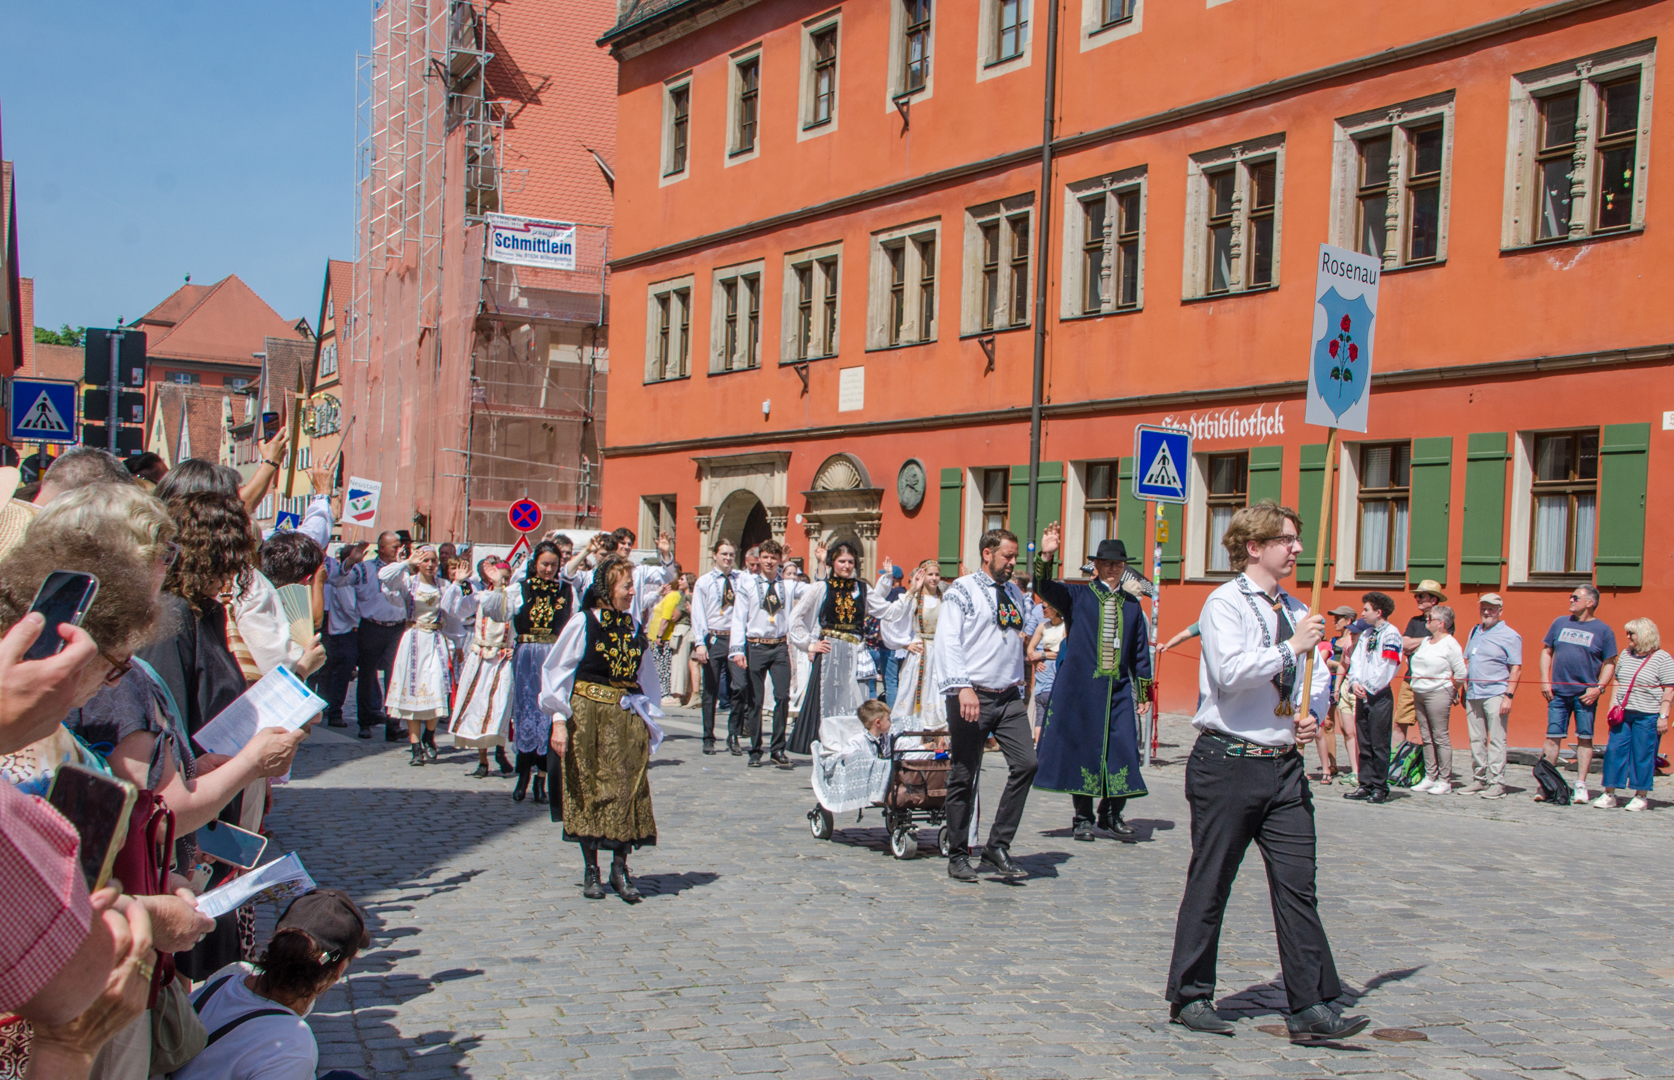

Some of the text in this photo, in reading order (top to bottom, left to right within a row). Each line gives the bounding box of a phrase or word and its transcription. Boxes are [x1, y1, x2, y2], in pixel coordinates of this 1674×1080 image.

[495, 232, 572, 255] Schmittlein
[1322, 251, 1377, 286] Rosenau
[1161, 401, 1285, 443] Stadtbibliothek
[350, 480, 380, 492] Neustadt
